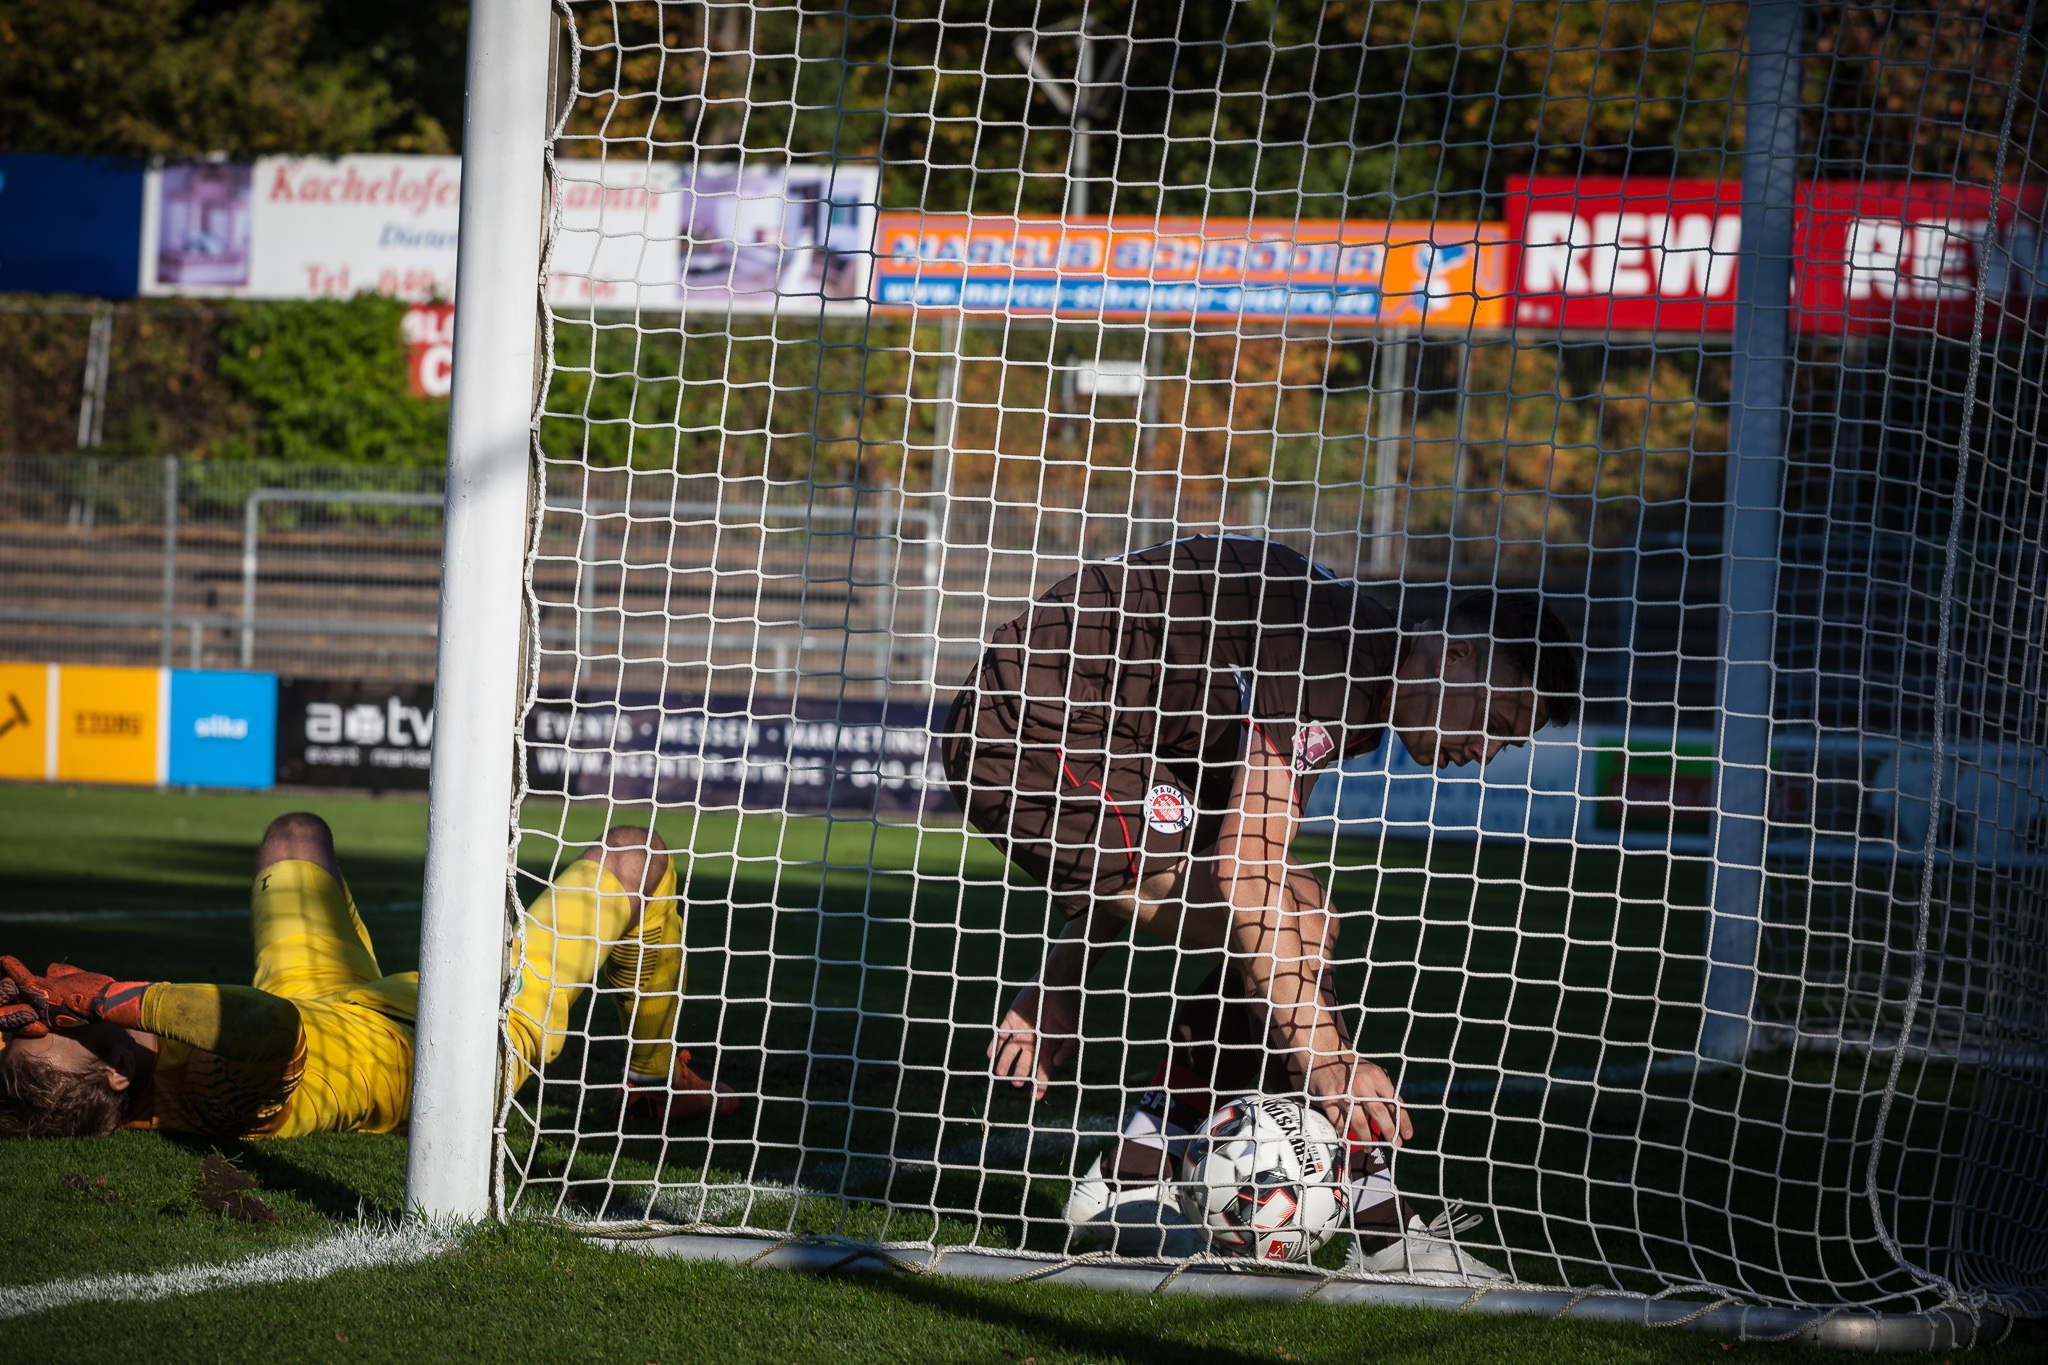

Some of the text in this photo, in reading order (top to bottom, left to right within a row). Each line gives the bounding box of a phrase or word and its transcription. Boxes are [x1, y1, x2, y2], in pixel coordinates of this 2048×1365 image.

[269, 163, 461, 216] Kachelofe
[889, 232, 1105, 270] MARCUS
[1524, 211, 1743, 295] REW
[1844, 216, 2048, 300] REW
[536, 711, 927, 756] EVENTS MESSEN MARKETING
[1153, 786, 1183, 799] PAULI
